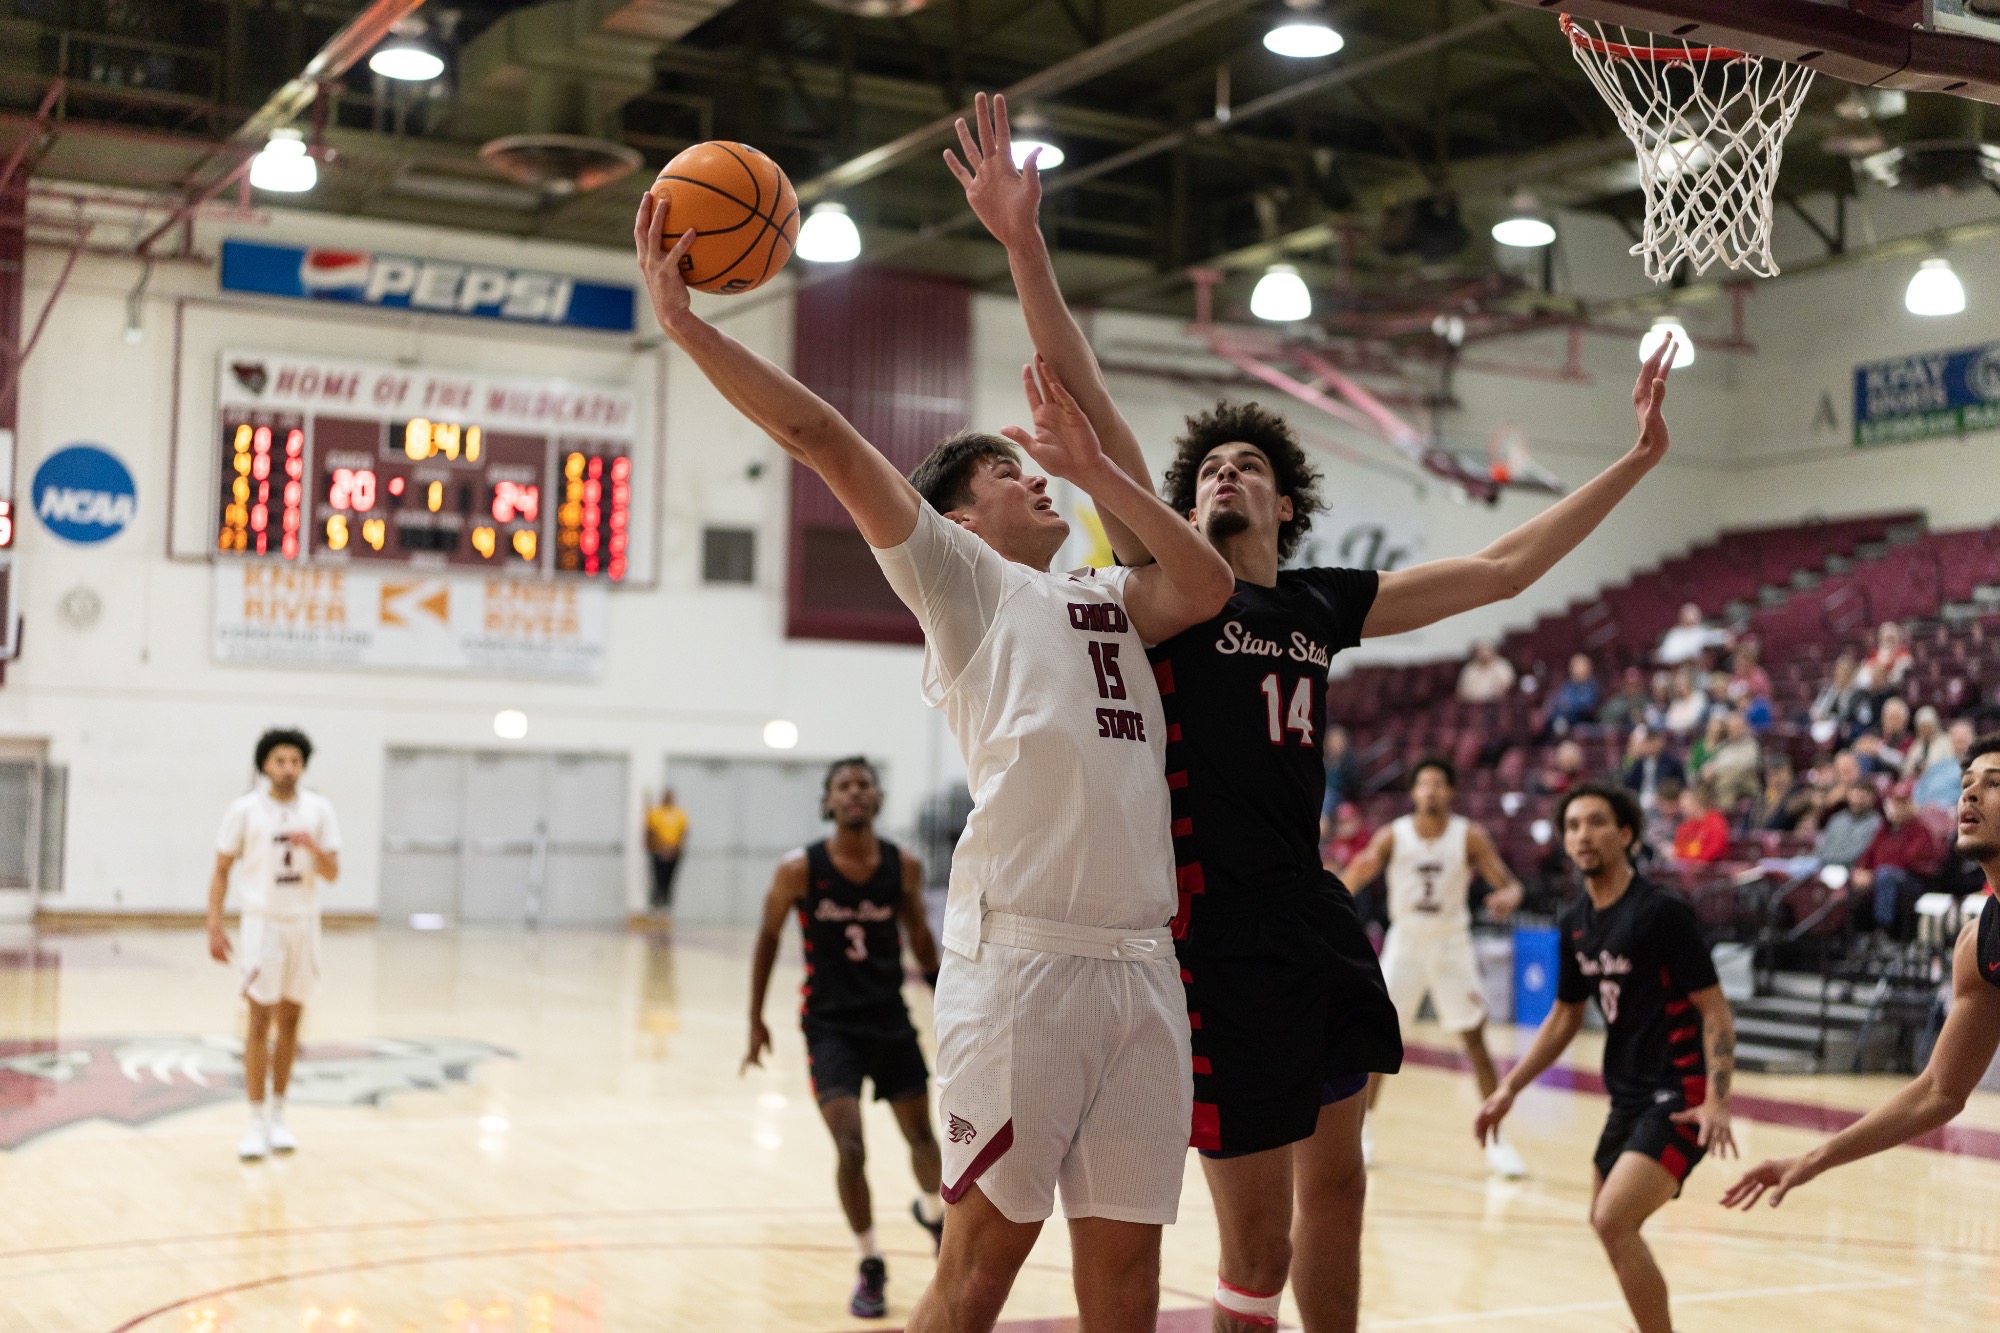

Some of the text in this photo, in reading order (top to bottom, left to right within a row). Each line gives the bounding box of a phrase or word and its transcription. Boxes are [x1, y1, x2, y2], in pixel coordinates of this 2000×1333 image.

[367, 257, 574, 321] PEPSI
[275, 367, 359, 398] HOME
[372, 374, 411, 408] OF
[421, 376, 473, 410] THE
[39, 485, 136, 527] NCAA
[1067, 602, 1128, 633] CHICO
[1216, 621, 1283, 658] Stan
[1088, 641, 1126, 700] 15
[1096, 707, 1146, 743] STATE
[1260, 672, 1315, 748] 14
[844, 924, 868, 962] 3
